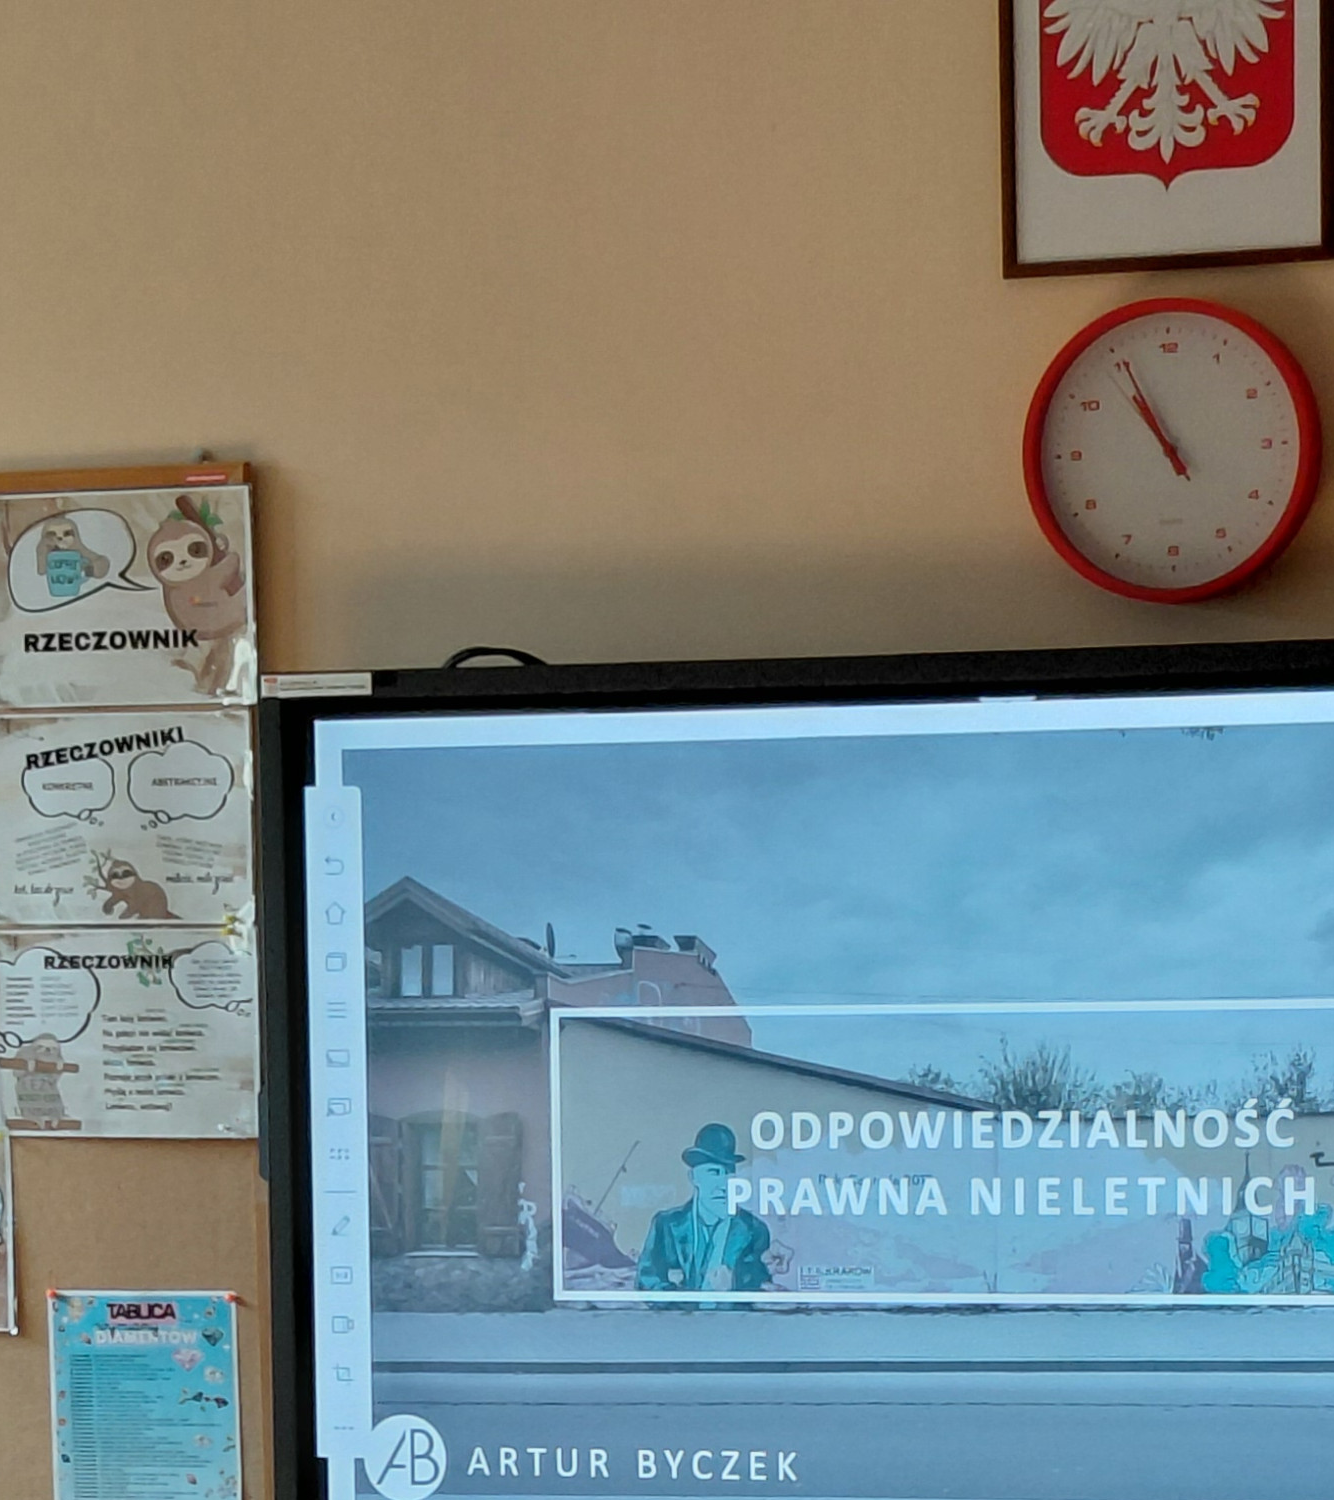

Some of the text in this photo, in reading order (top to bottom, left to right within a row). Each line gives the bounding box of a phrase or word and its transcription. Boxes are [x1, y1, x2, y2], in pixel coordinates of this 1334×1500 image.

[1248, 490, 1259, 500] 4
[1122, 534, 1132, 544] 7
[24, 629, 199, 653] RZECZOWNIK
[25, 726, 186, 770] RZECZOWNIKI
[44, 955, 175, 969] RZECZOWNIK
[750, 1098, 1295, 1150] ODPOWIEDZIALNOŚĆ
[727, 1176, 948, 1215] PRAWNA
[971, 1176, 1316, 1216] NIELETNICH
[467, 1446, 610, 1479] ARTUR
[638, 1448, 800, 1483] BYCZEK
